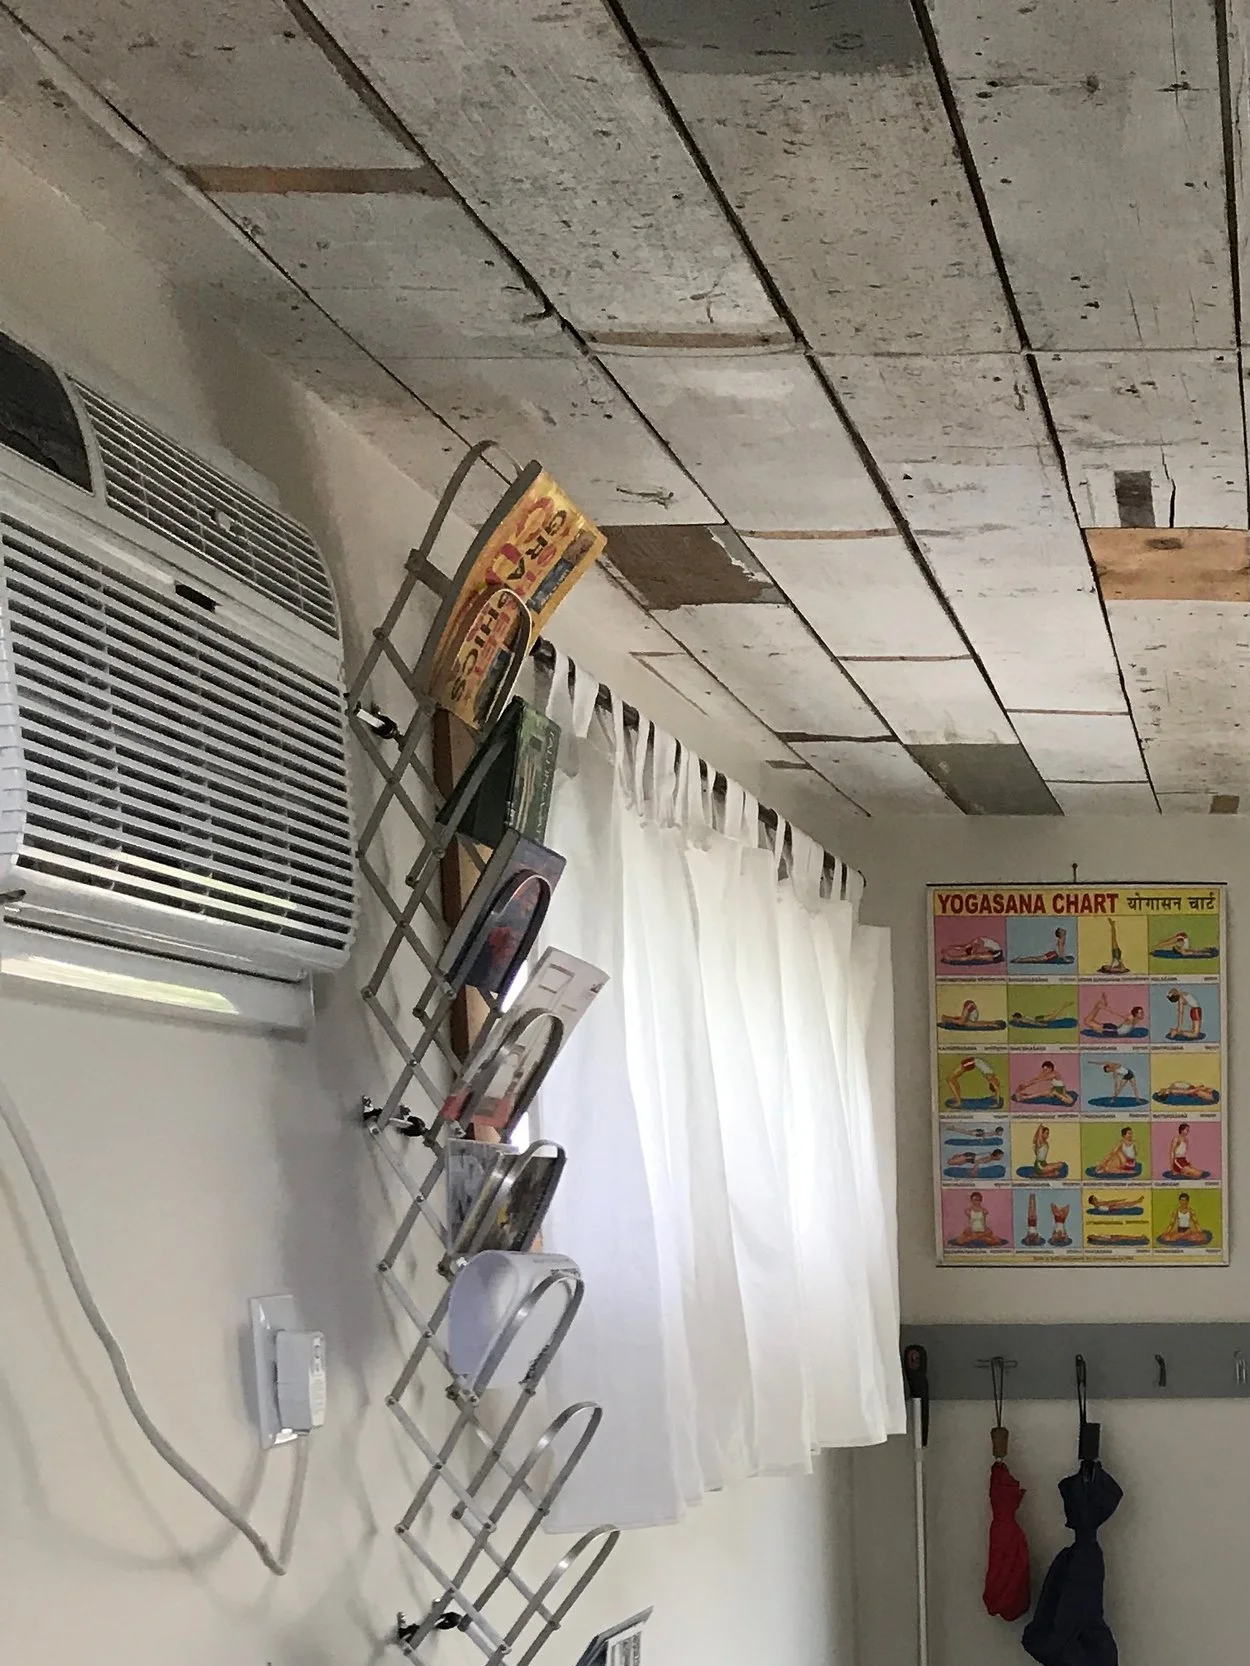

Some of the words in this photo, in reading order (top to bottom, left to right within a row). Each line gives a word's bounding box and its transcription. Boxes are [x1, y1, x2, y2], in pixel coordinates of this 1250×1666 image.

[450, 510, 568, 702] GRAPHICS
[937, 893, 1047, 914] YOGASANA
[1051, 893, 1119, 914] CHART
[1126, 894, 1182, 911] योगासन
[1187, 892, 1216, 910] चार्ट
